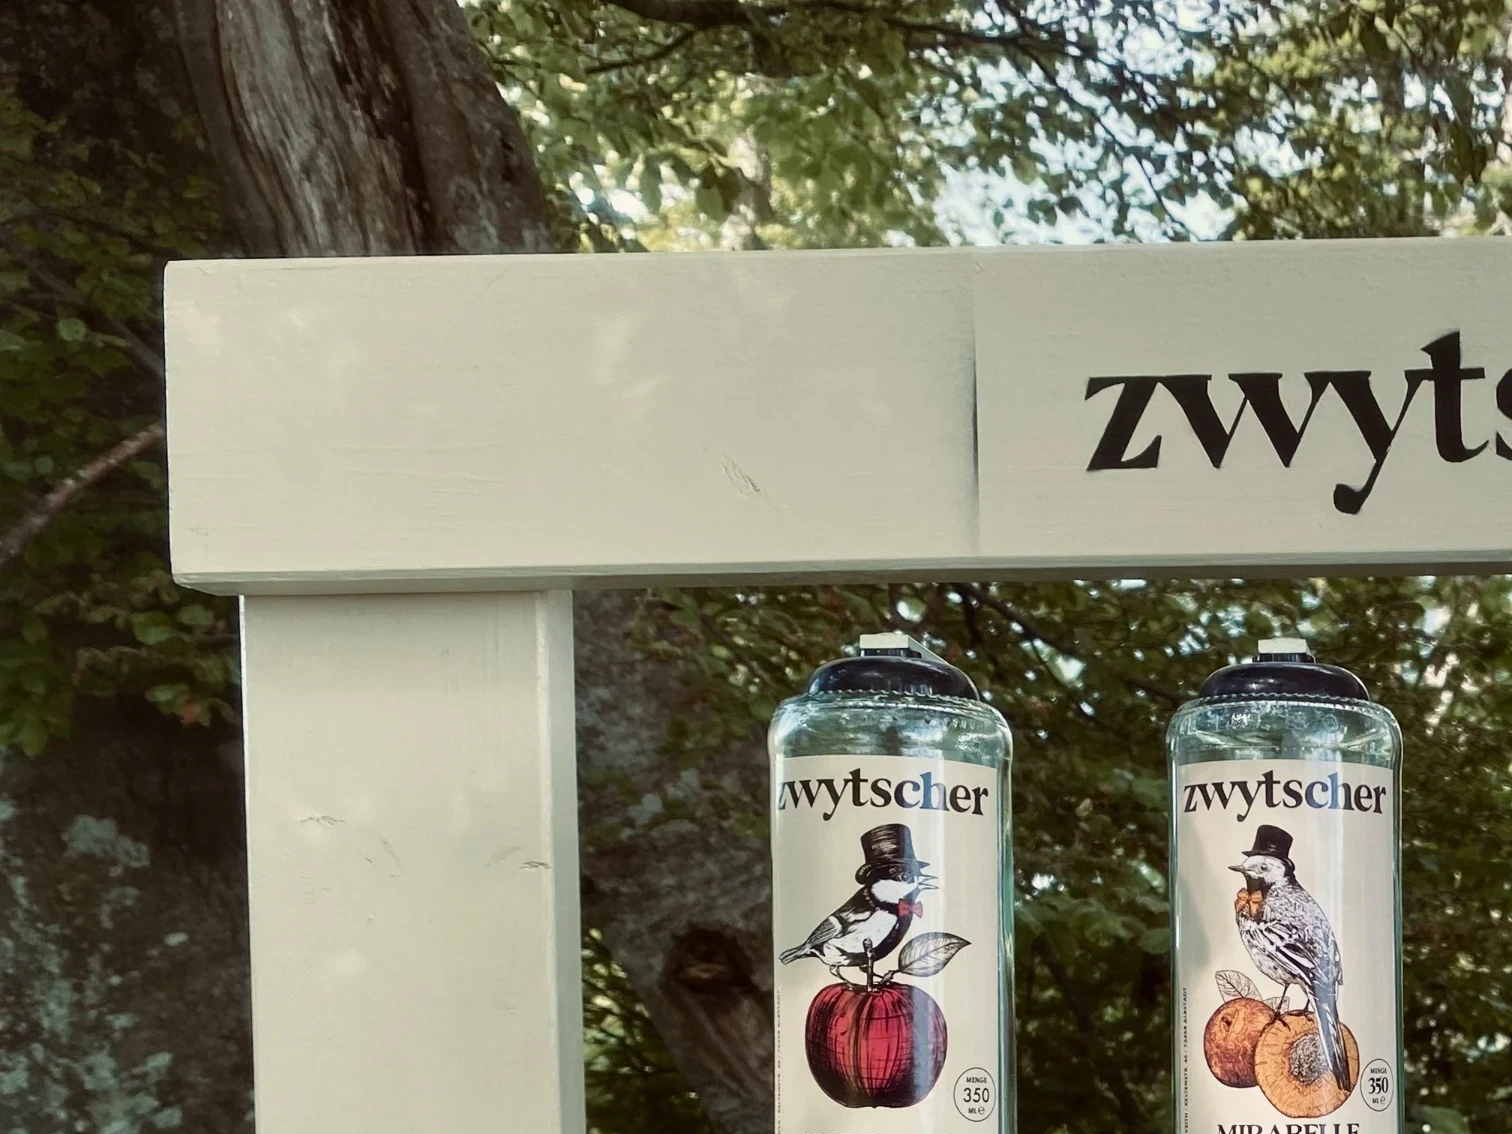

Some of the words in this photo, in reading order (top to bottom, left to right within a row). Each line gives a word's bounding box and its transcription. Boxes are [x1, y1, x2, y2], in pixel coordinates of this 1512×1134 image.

[1184, 770, 1386, 822] zwytscher
[1368, 1077, 1389, 1094] 350
[963, 1087, 990, 1103] 350
